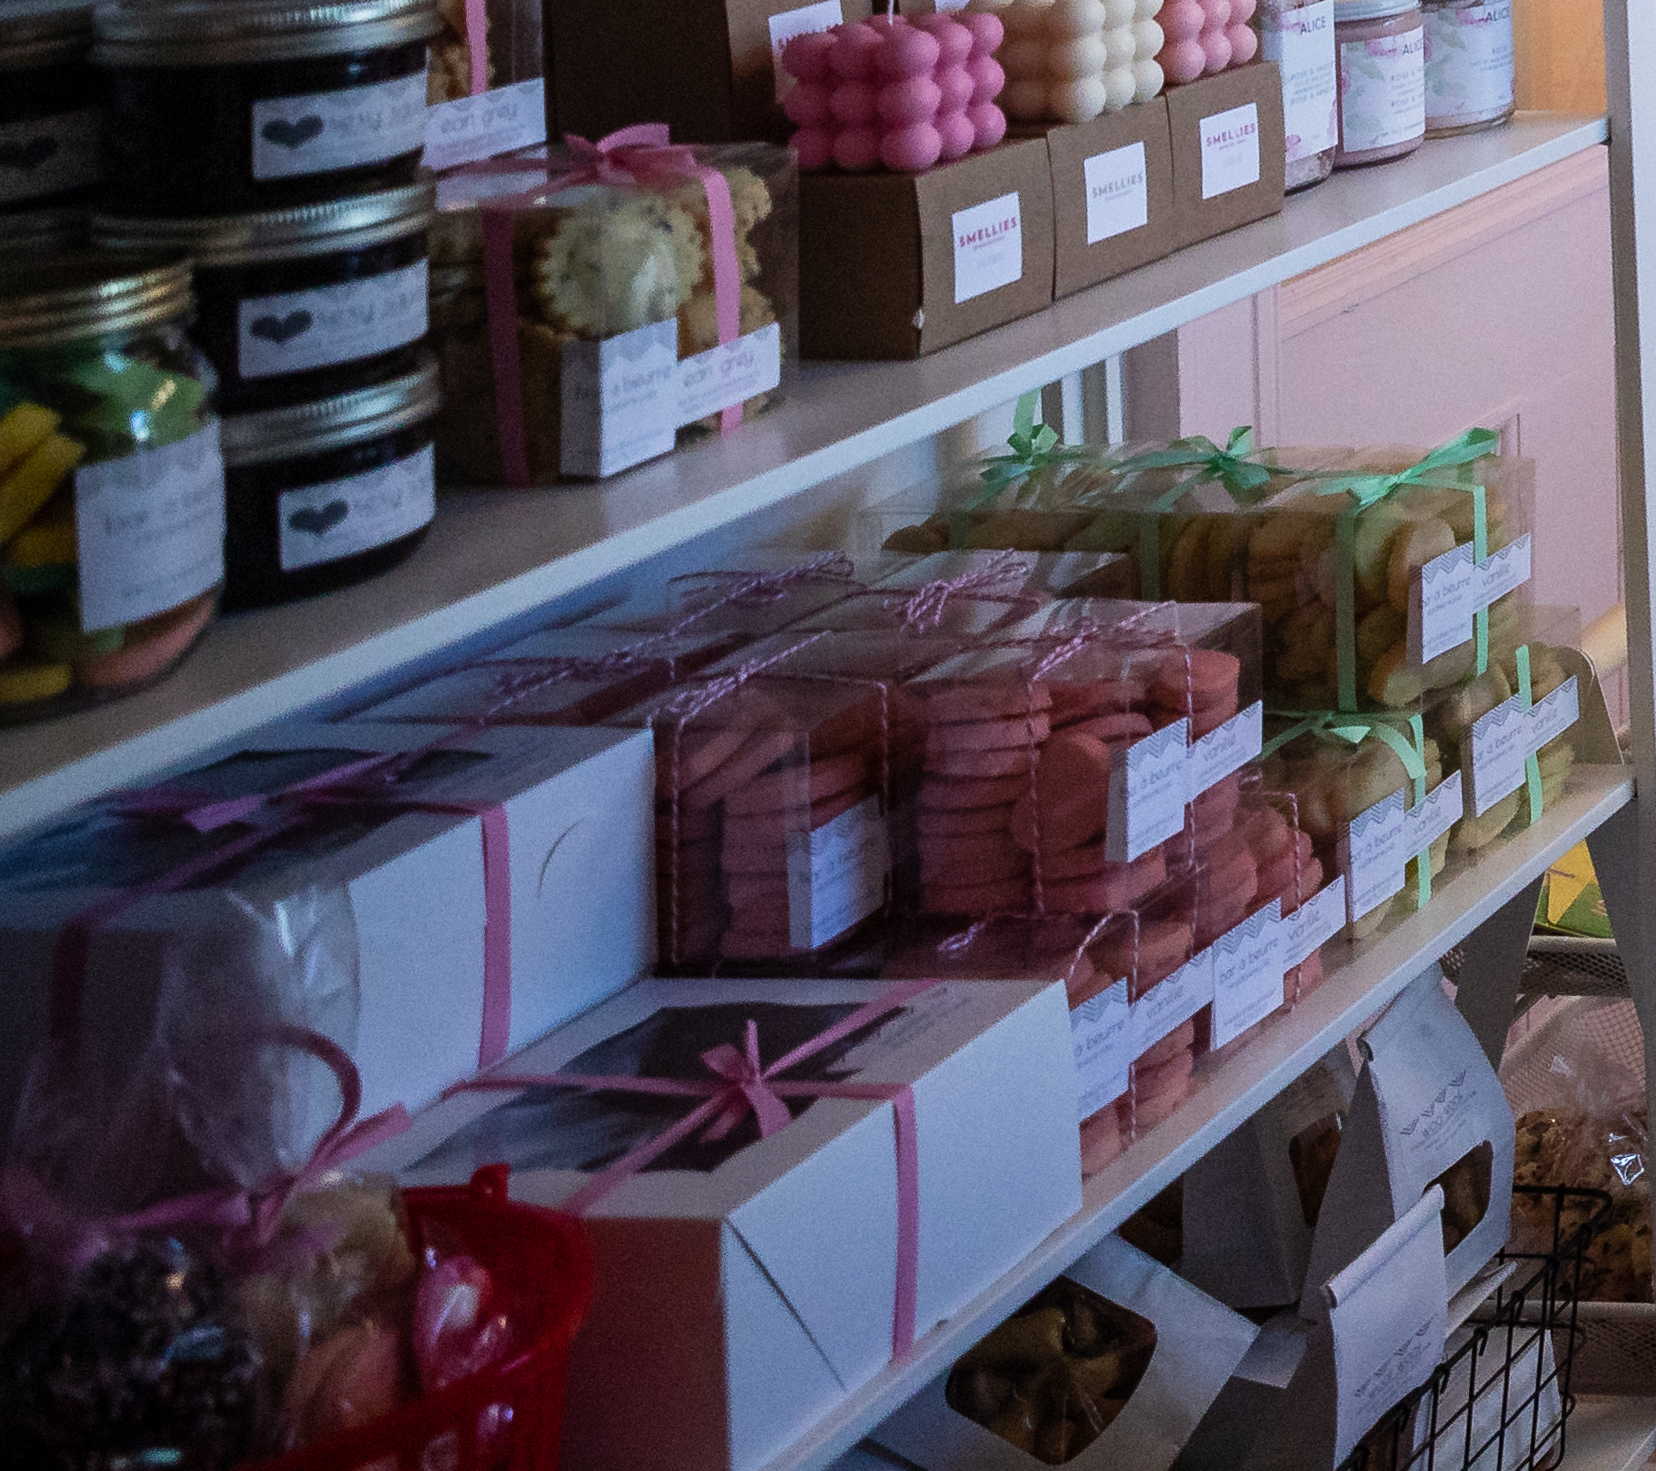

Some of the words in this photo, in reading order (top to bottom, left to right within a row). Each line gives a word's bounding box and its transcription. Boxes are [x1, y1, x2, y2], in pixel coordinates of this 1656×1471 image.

[1300, 15, 1327, 35] ALICE
[481, 103, 519, 125] grey
[1206, 122, 1257, 148] SMELLIES
[1091, 172, 1144, 199] SMELLIES
[959, 216, 1018, 248] SMELLIES
